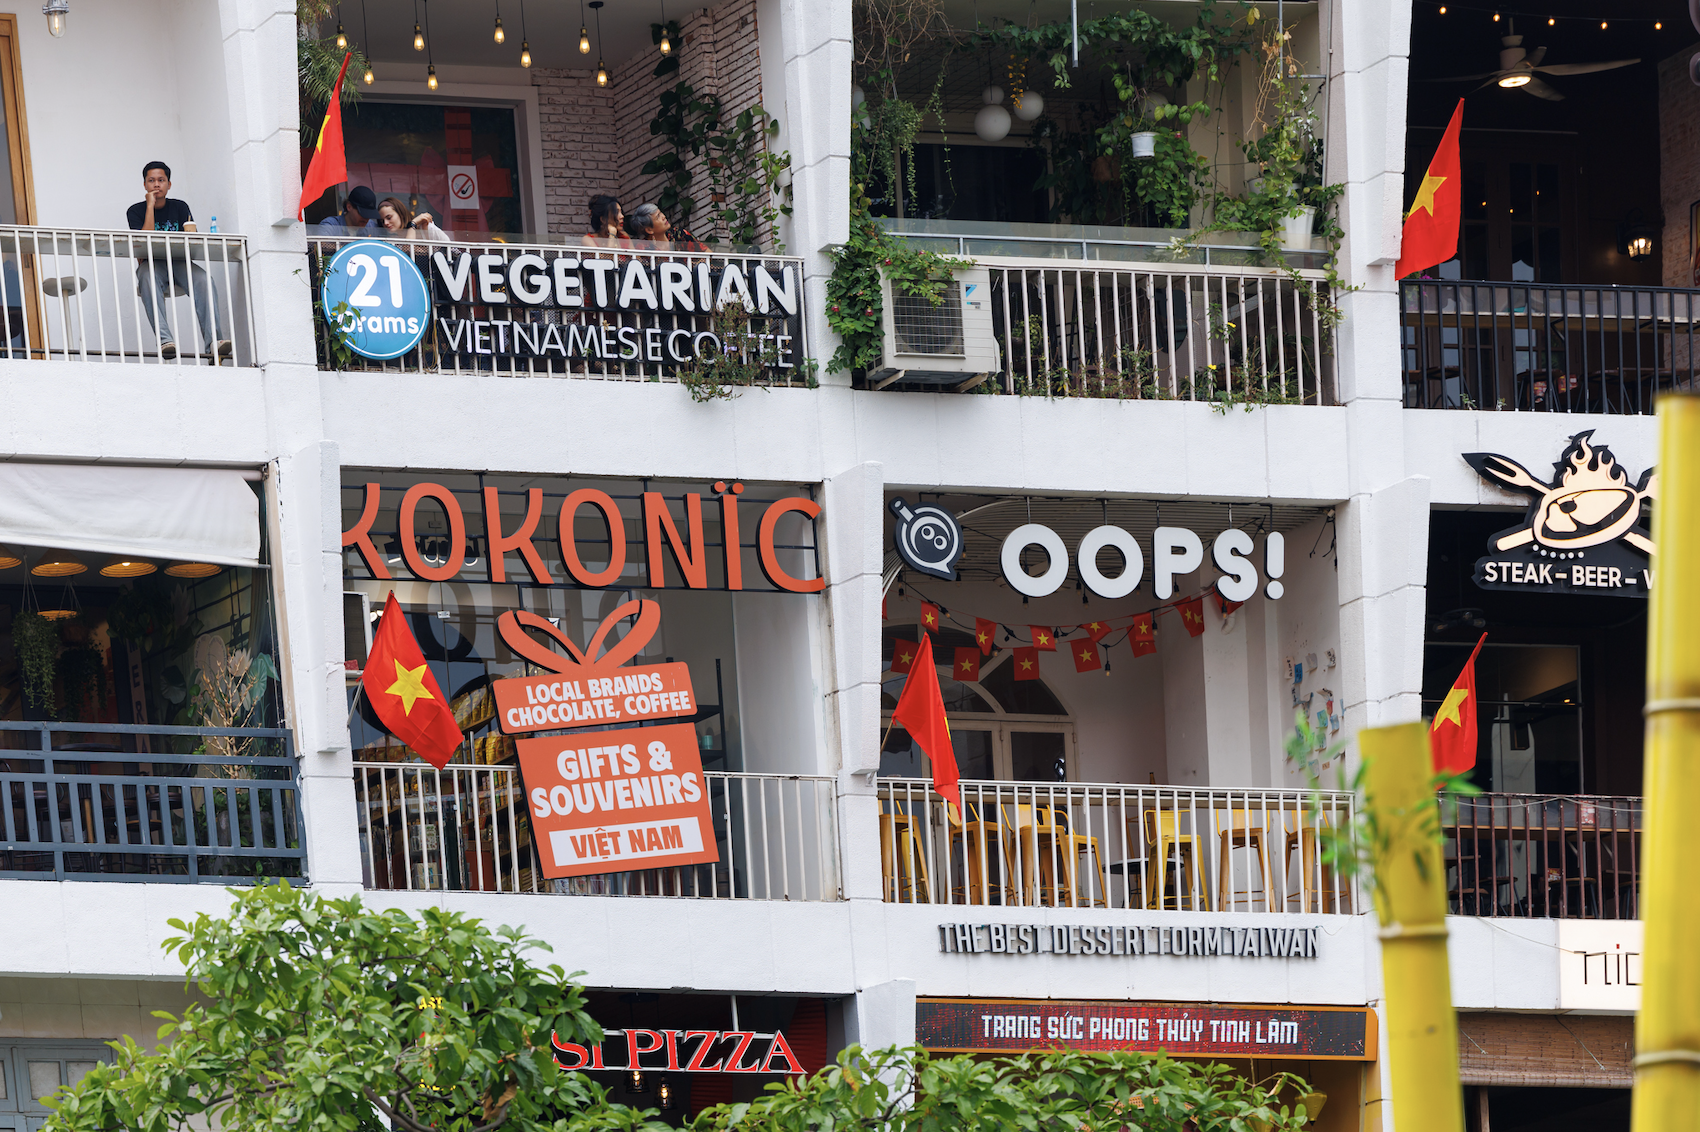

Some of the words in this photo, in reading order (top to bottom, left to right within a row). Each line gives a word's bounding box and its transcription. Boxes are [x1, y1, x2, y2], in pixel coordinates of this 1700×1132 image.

[347, 253, 403, 308] 21
[433, 252, 797, 315] VEGETARIAN
[439, 317, 664, 361] VIETNAMESE
[1000, 523, 1284, 602] OOPS!
[1484, 561, 1553, 585] STEAK
[1572, 565, 1622, 588] BEER
[507, 698, 621, 727] CHOCOLATE,
[624, 691, 691, 715] COFFEE
[526, 681, 585, 705] LOCAL
[588, 673, 663, 699] BRANDS
[557, 743, 641, 781] GIFTS
[647, 740, 674, 772] &
[531, 771, 702, 818] SOUVENIRS
[570, 827, 621, 860] VIỆT
[627, 825, 684, 853] NAM
[939, 924, 985, 953] THE
[990, 924, 1048, 954] BEST
[1051, 924, 1152, 955] DESSERT
[1157, 926, 1222, 957] FORM
[1229, 927, 1320, 958] TAIWAN
[982, 1014, 1041, 1039] TRANG
[1047, 1010, 1084, 1040] SỨC
[1089, 1016, 1150, 1041] PHONG
[1156, 1012, 1203, 1042] THỦY
[1210, 1019, 1250, 1043] TINH
[1255, 1018, 1299, 1044] LÂM
[621, 1028, 808, 1074] PIZZA
